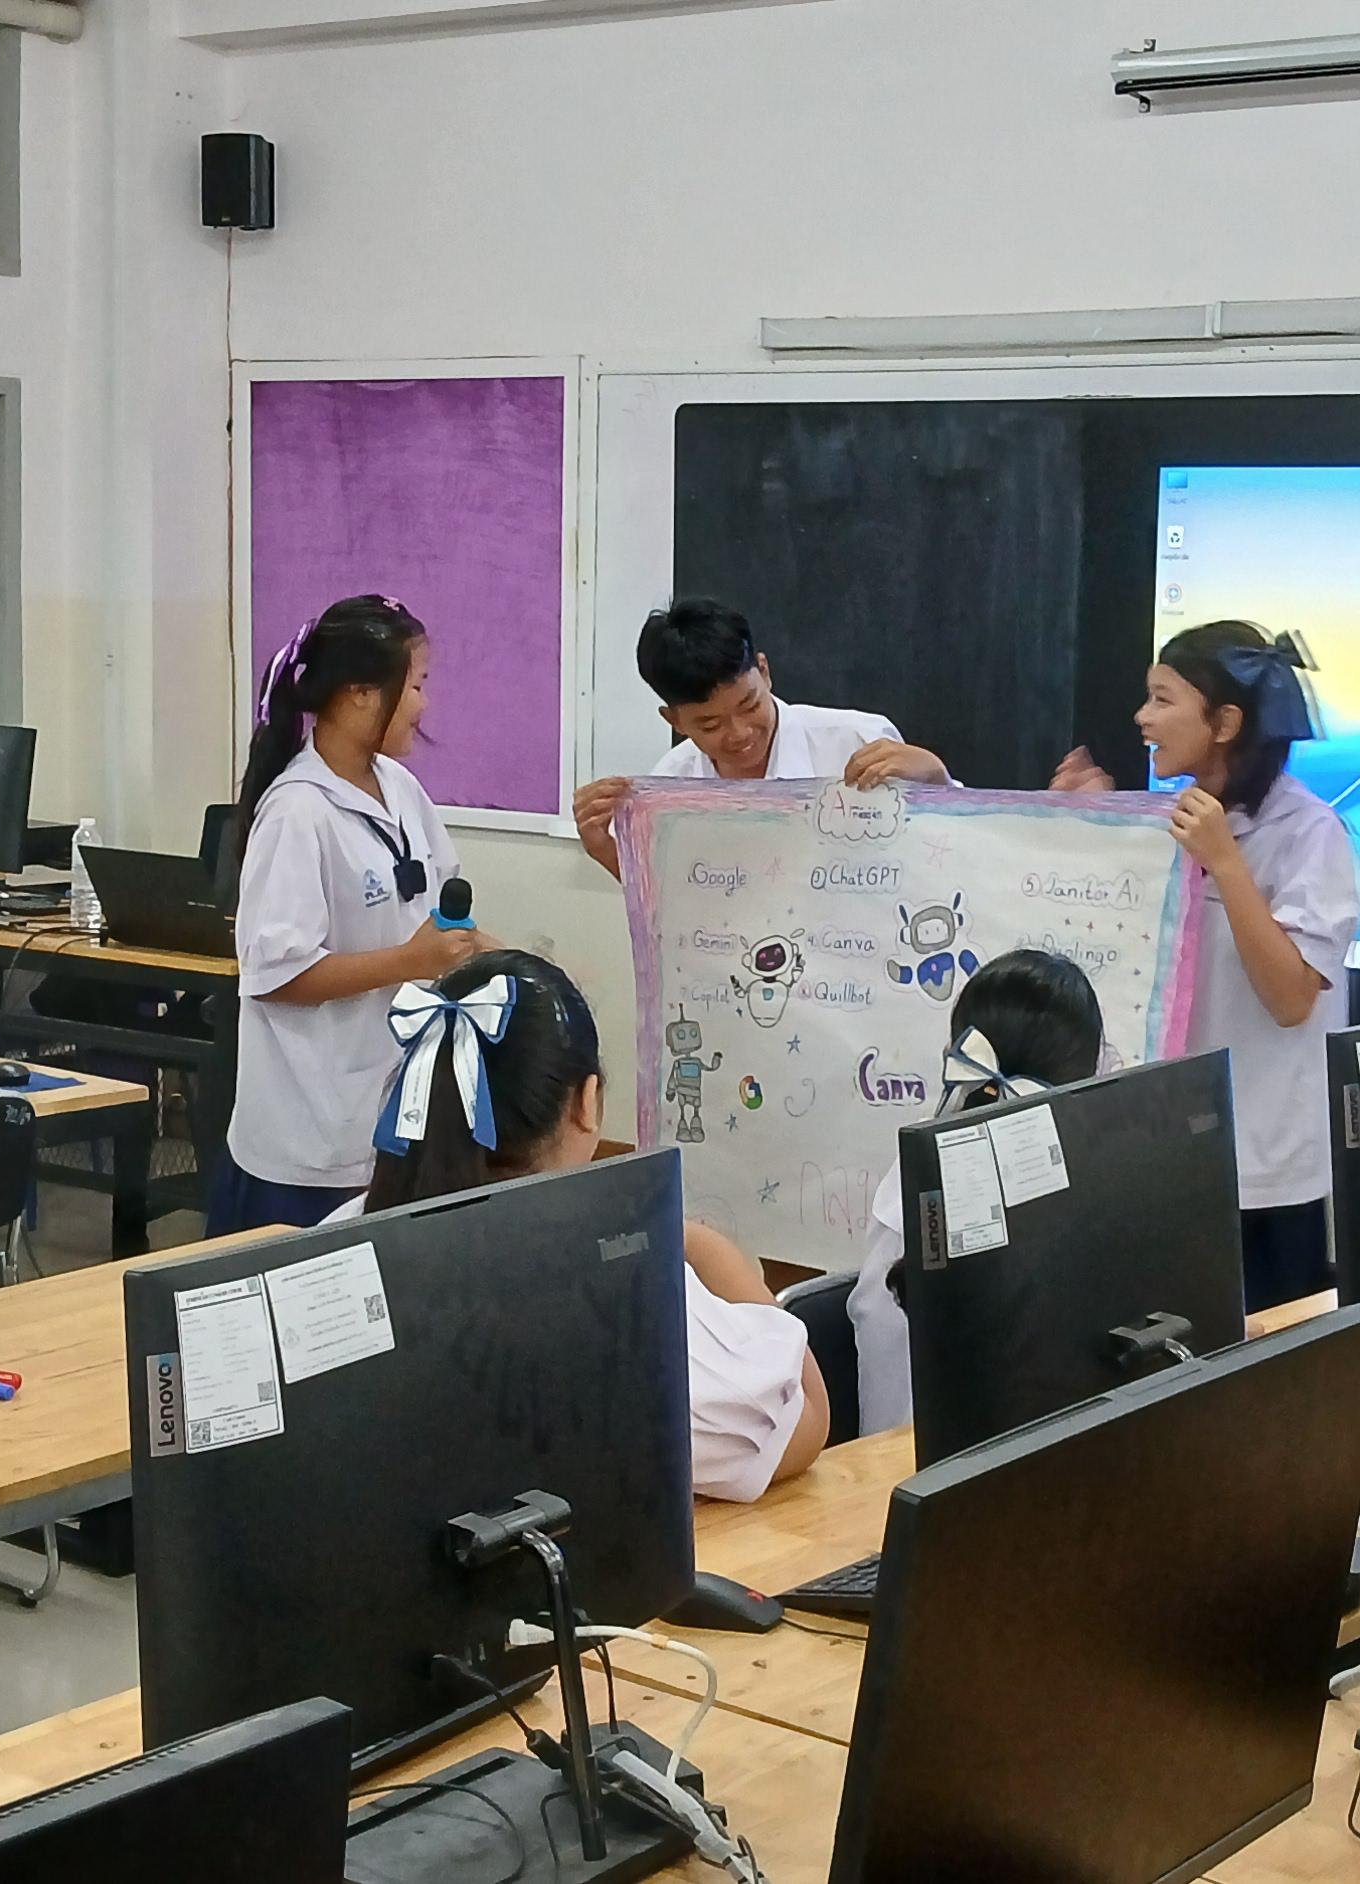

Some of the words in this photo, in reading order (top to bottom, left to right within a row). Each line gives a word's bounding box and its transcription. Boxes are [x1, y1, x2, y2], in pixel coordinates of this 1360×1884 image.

[829, 863, 900, 887] ChatGPT
[821, 930, 875, 952] Canva
[858, 1053, 927, 1103] Canva
[927, 1199, 941, 1263] Lenovo
[158, 1361, 176, 1447] Lenovo
